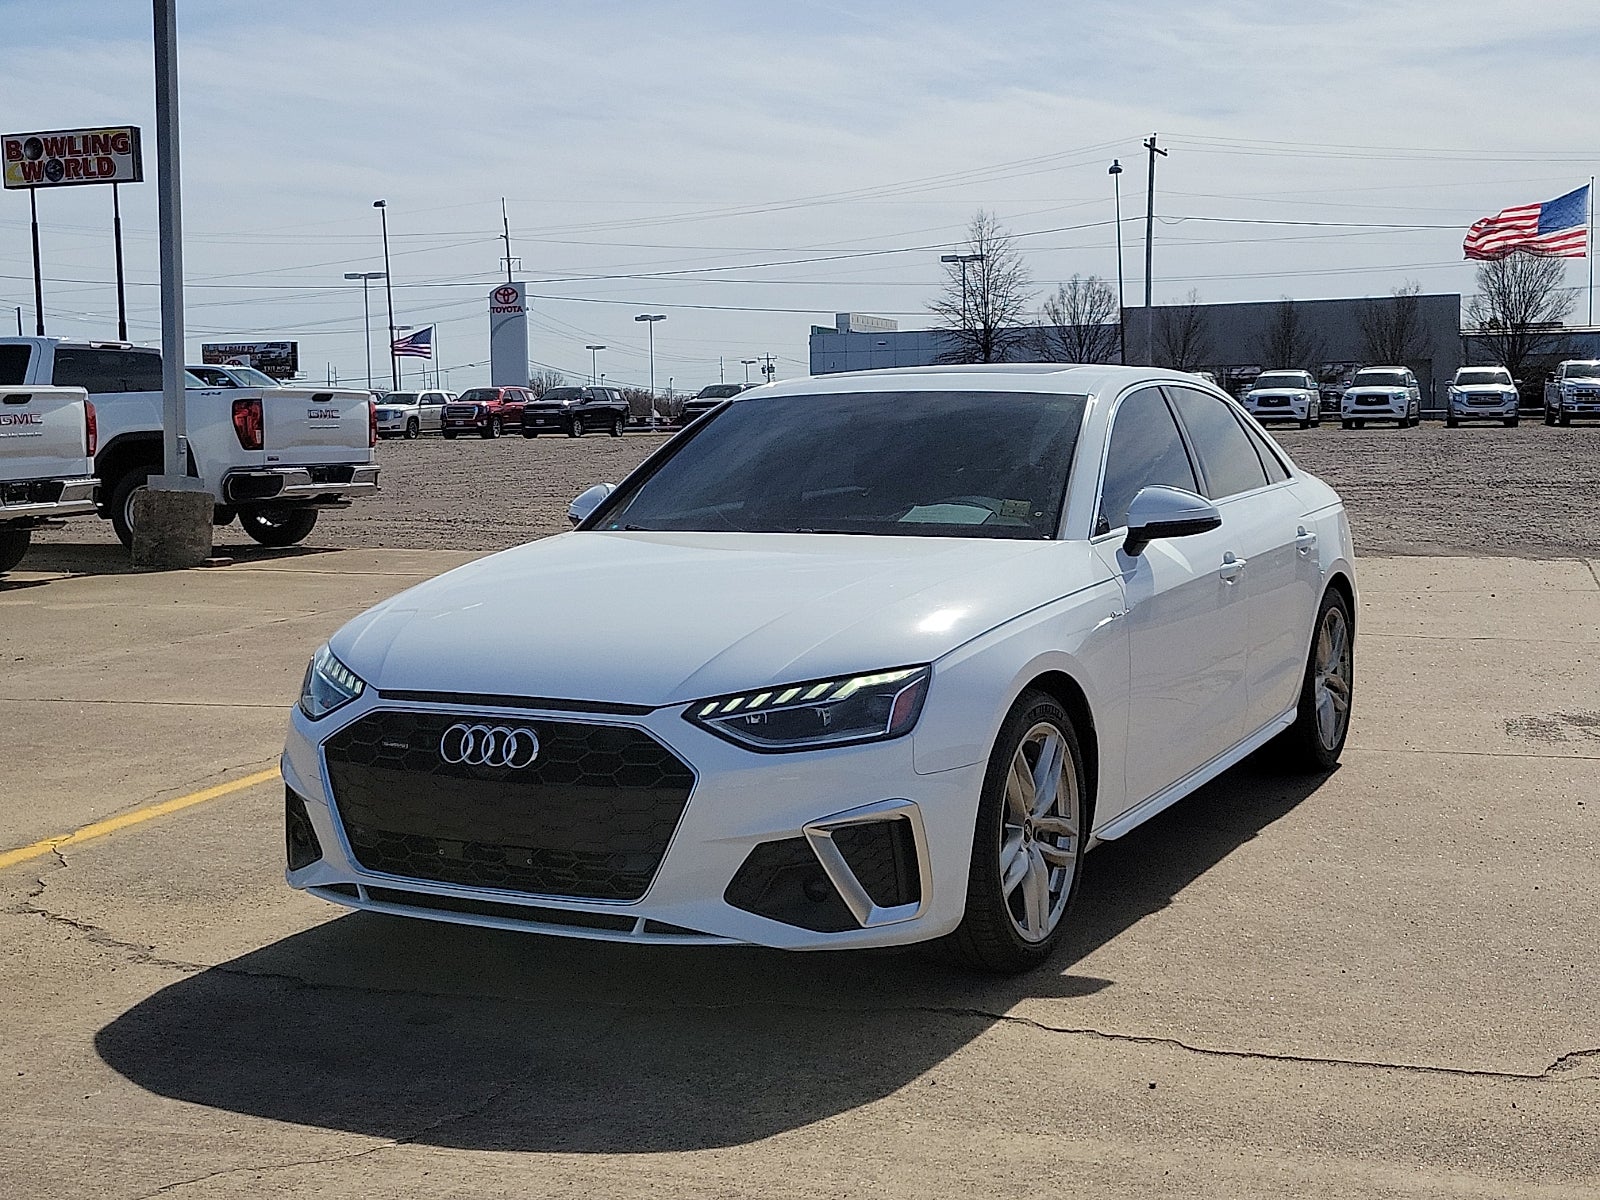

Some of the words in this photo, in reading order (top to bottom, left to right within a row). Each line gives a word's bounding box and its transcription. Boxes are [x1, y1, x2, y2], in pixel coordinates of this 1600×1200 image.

[5, 132, 131, 161] BOWLING
[20, 156, 117, 183] WORLD
[490, 305, 523, 313] TOYOTA
[0, 413, 43, 426] GMC
[307, 409, 341, 419] GMC
